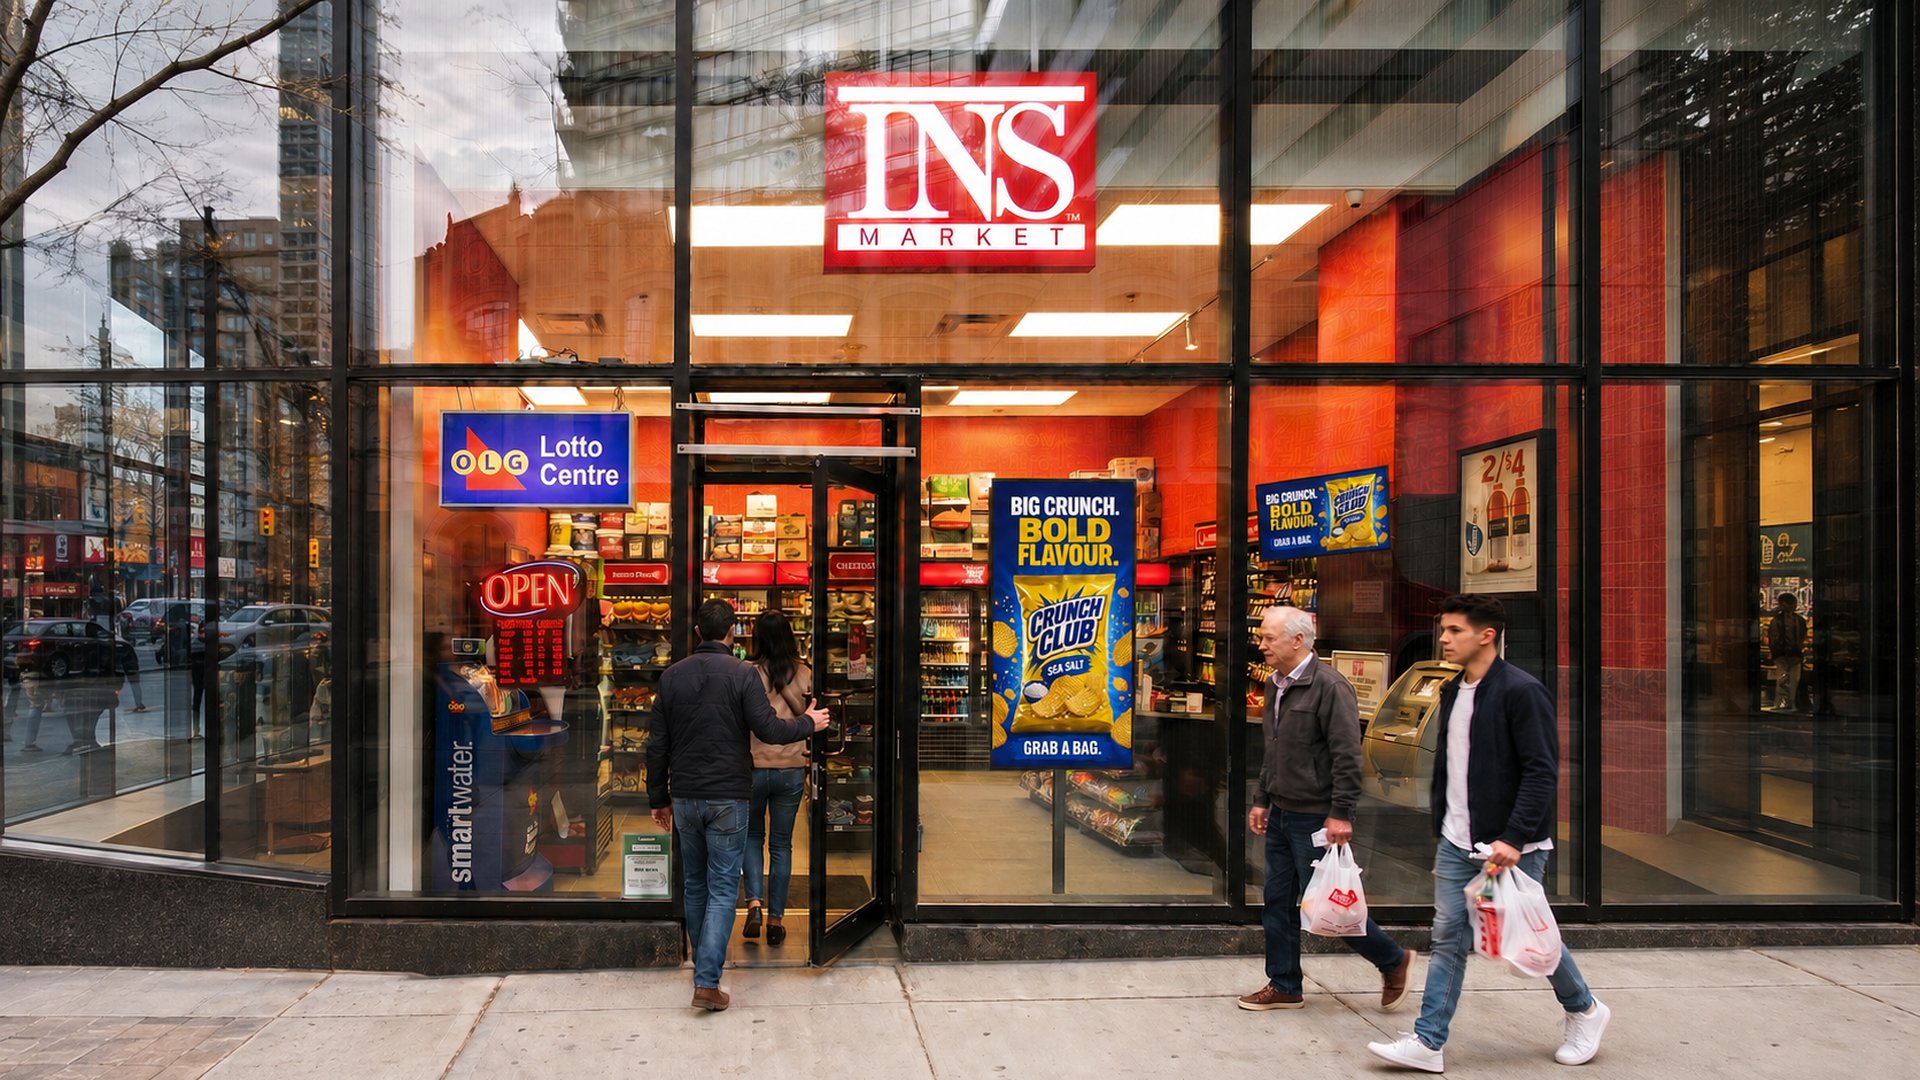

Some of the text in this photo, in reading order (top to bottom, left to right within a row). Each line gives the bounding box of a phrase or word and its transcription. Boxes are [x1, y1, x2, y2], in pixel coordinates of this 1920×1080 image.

[847, 102, 1075, 222] INS
[860, 228, 1064, 246] MARKET
[540, 435, 603, 457] Lotto
[454, 453, 523, 471] OLG
[540, 463, 619, 486] Centre
[1011, 496, 1120, 516] BIG CRUNCH.
[1266, 493, 1280, 506] BIG
[1270, 501, 1312, 519] BOLD
[1019, 517, 1111, 543] BOLD
[1270, 515, 1318, 532] FLAVOUR.
[1291, 536, 1297, 546] A
[1018, 543, 1119, 566] FLAVOUR.
[484, 573, 570, 609] OPEN
[1030, 597, 1103, 639] CRUNCH
[1039, 618, 1095, 656] CLUB
[1047, 659, 1085, 676] SEA SALT
[1024, 740, 1102, 755] GRAB A BAG.
